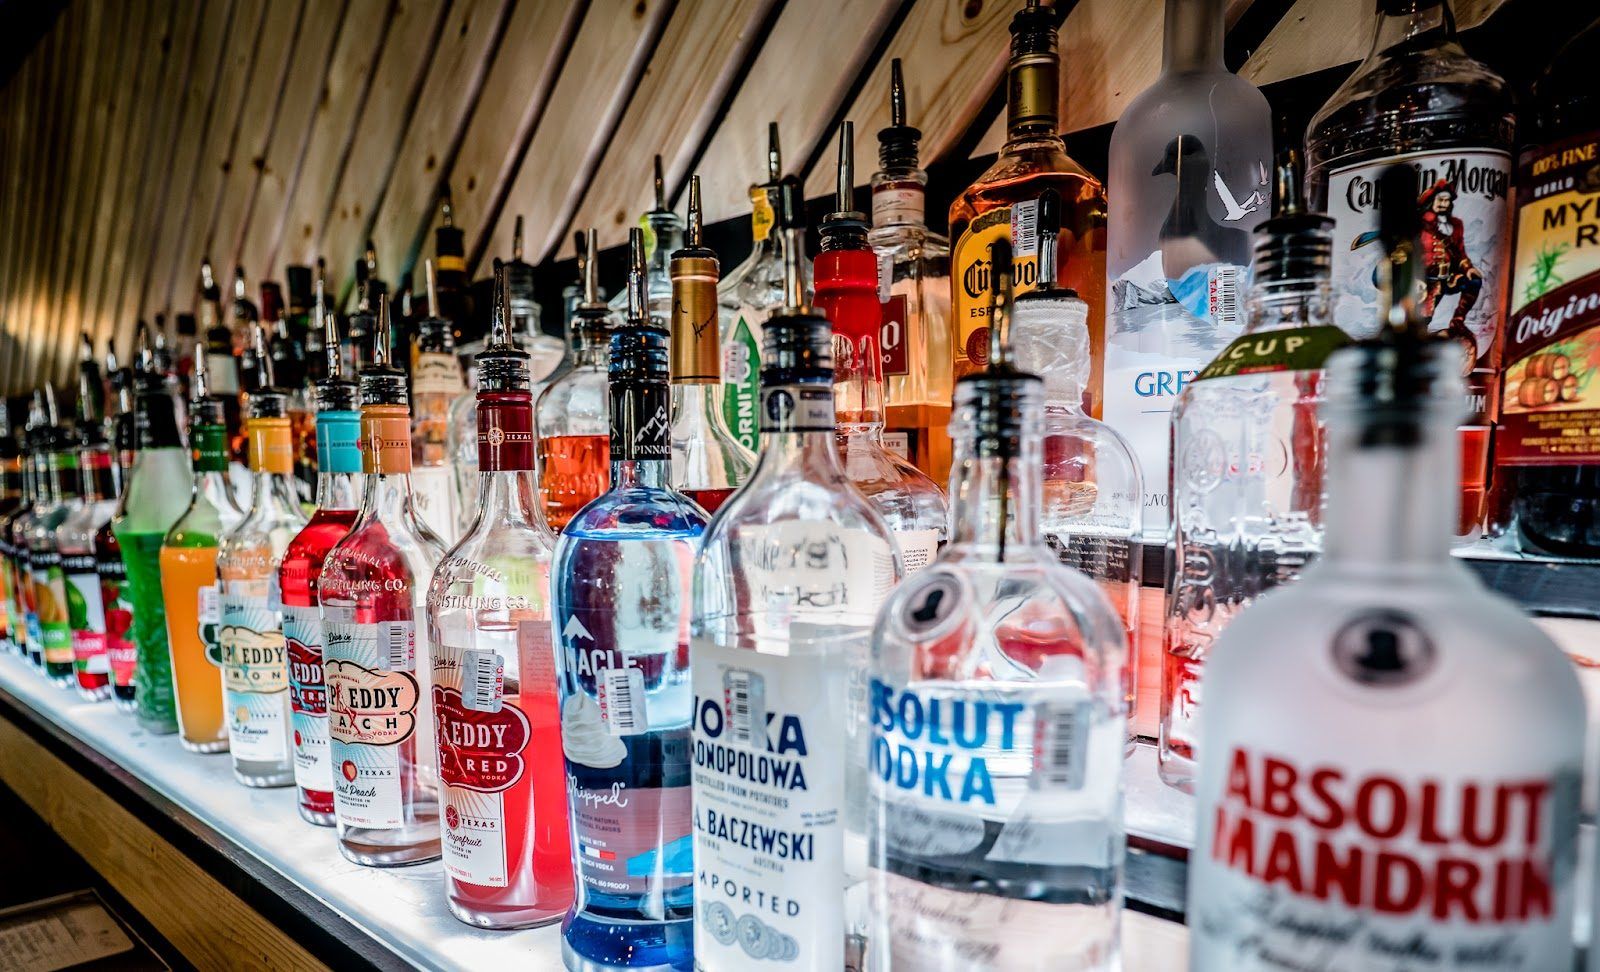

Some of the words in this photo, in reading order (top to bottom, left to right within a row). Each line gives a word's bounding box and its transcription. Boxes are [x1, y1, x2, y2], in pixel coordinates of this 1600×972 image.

[1562, 143, 1597, 167] FINE
[1440, 157, 1509, 201] Morga
[1534, 177, 1574, 198] WORLD
[1576, 223, 1600, 248] R
[963, 258, 1036, 299] Cuvo
[386, 440, 409, 448] TEXAS
[506, 433, 533, 441] TEXAS
[385, 578, 407, 591] CO.
[242, 646, 285, 664] EDDY
[293, 662, 322, 684] EDD
[495, 666, 504, 700] T.A.B.C.
[349, 687, 400, 709] EDDY
[870, 679, 1024, 751] SOLUT
[360, 768, 392, 776] TEXAS
[467, 759, 508, 773] RED
[691, 740, 808, 791] ONOPOLOWA
[870, 734, 997, 805] ODKA
[350, 784, 377, 798] Peach
[1226, 745, 1556, 850] ABSOLUT
[461, 818, 496, 829] TEXAS
[446, 828, 483, 848] Grapefruit
[593, 837, 607, 848] WITH
[708, 809, 815, 862] BACZEWSKI
[595, 861, 615, 873] VODKA
[1212, 807, 1555, 926] MANDRIN
